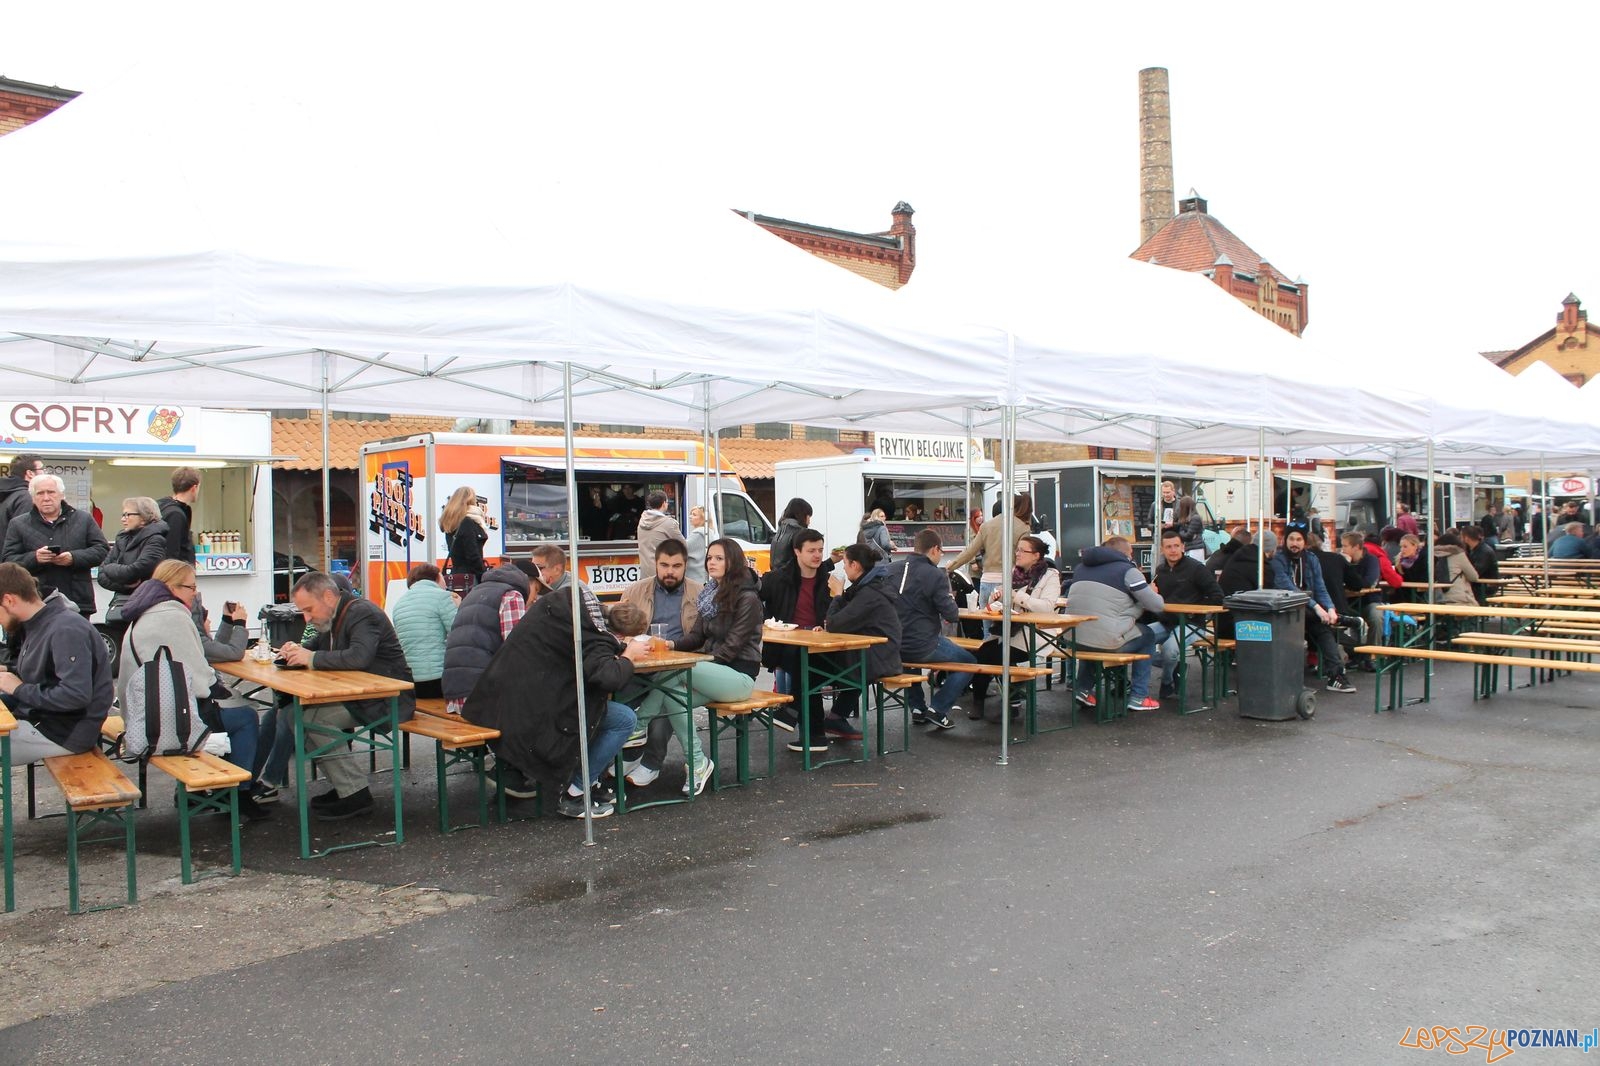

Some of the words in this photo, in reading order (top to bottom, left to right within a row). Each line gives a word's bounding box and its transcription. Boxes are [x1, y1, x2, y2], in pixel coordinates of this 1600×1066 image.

[10, 403, 140, 434] GOFRY
[880, 437, 915, 456] FRYTKI
[917, 440, 964, 459] BELGIJSKIE
[46, 465, 87, 475] GOFRY
[206, 556, 251, 570] LODY
[592, 567, 641, 583] BURG
